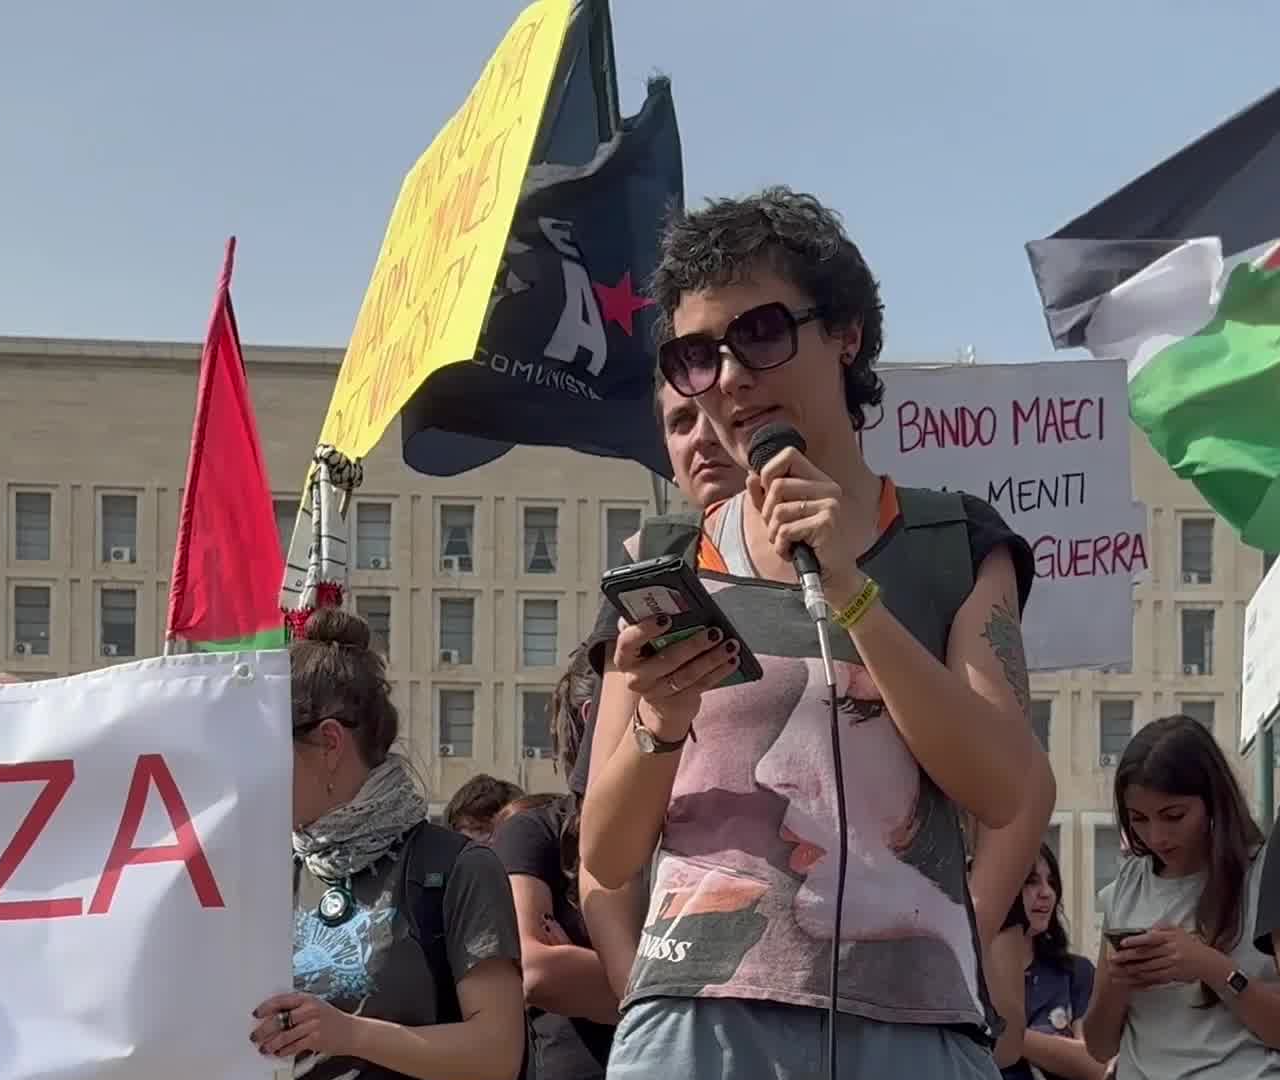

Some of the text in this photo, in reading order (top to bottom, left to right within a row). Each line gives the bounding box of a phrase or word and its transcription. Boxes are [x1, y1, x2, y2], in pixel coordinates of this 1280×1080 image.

[897, 396, 1104, 453] BANDO MAECI
[1032, 531, 1149, 580] GUERRA
